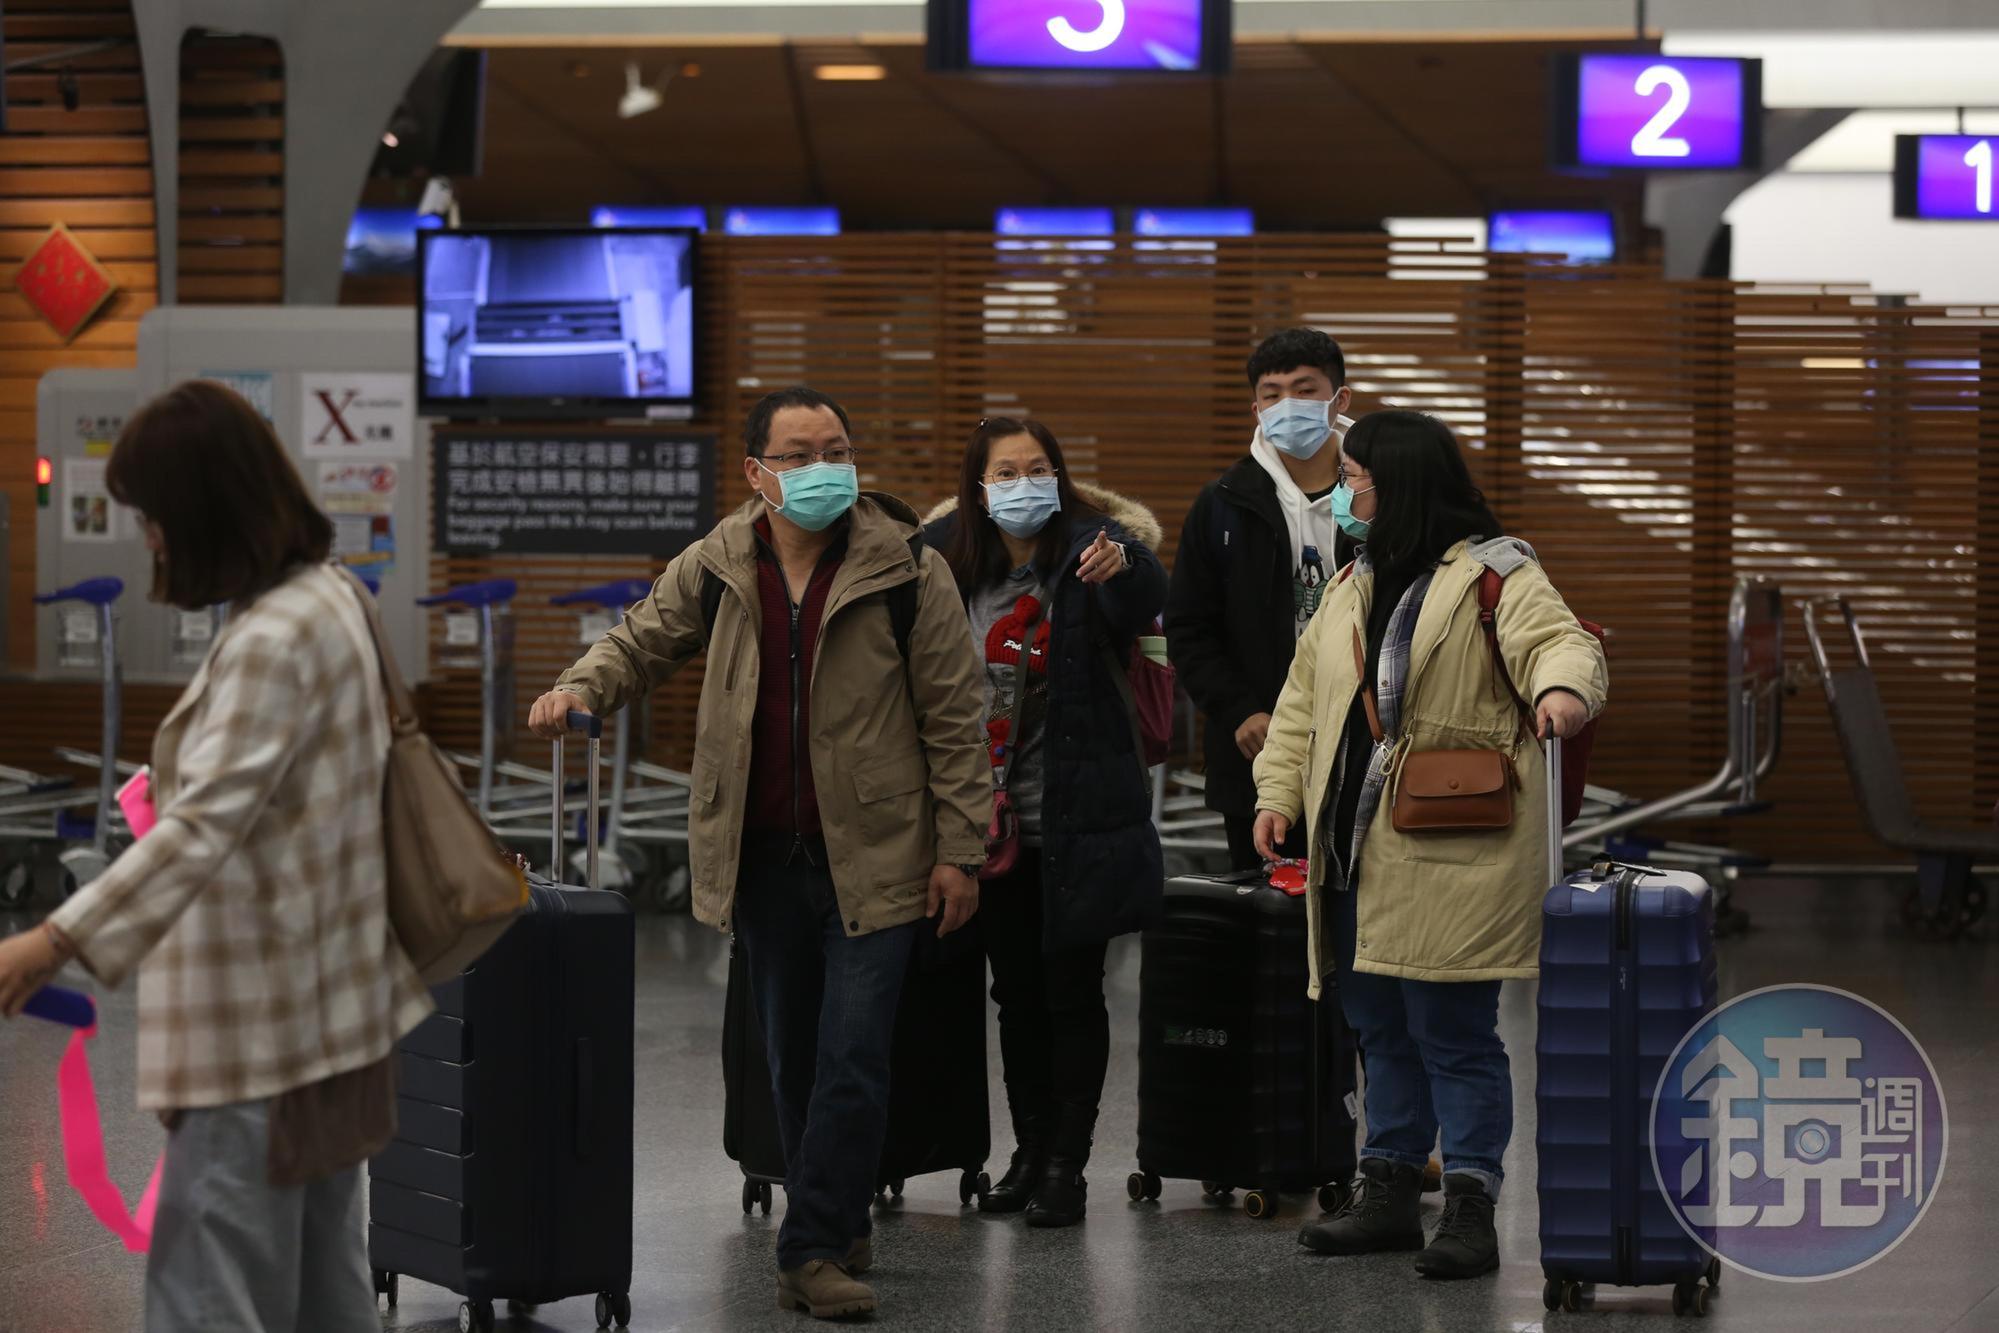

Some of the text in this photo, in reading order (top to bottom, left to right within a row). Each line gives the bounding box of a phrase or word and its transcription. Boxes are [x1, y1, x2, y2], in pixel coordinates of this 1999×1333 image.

[1631, 65, 1690, 157] 2
[1963, 140, 1992, 213] 1
[311, 389, 361, 445] X
